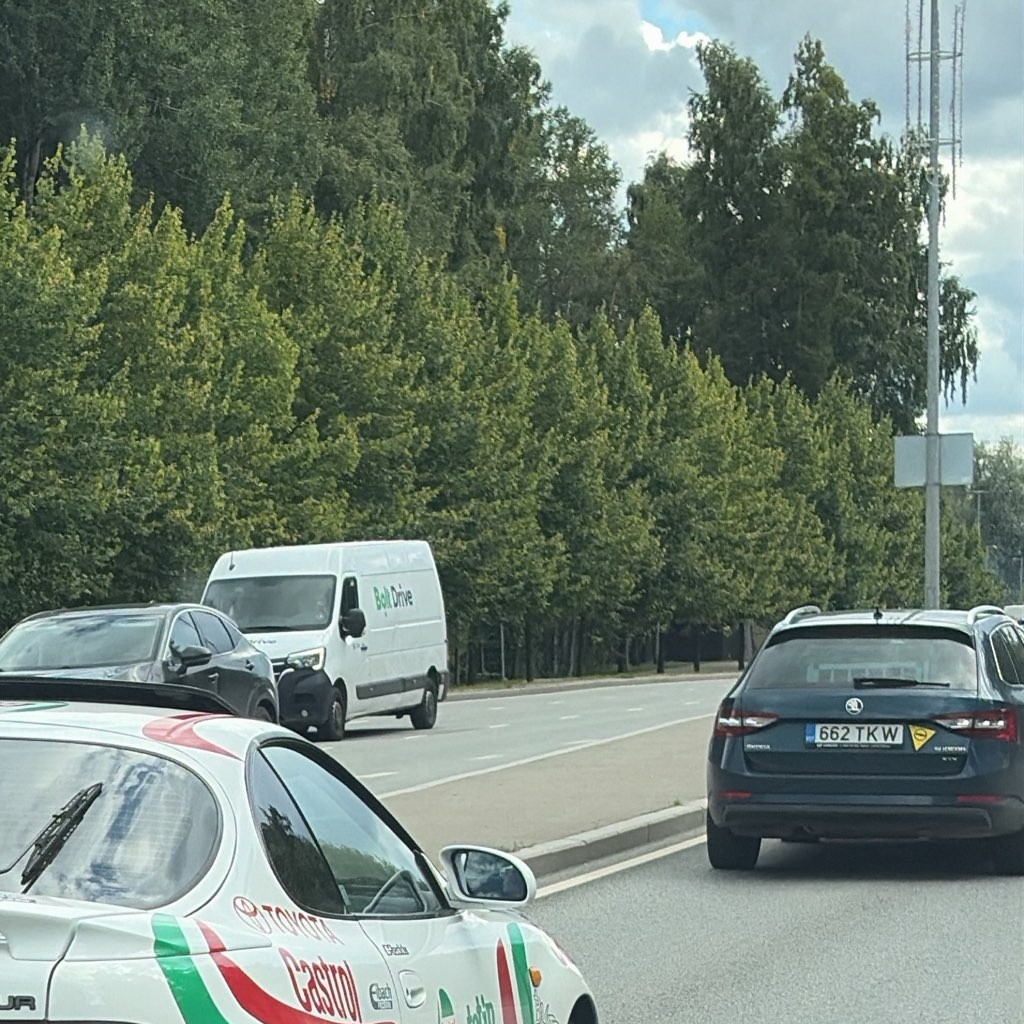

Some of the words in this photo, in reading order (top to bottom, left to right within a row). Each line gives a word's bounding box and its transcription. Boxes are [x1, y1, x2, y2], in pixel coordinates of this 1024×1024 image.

[373, 586, 392, 611] Bolt
[391, 584, 413, 608] Drive
[819, 726, 850, 742] 662
[262, 904, 346, 946] TOYOTA
[279, 947, 363, 1024] Castrol
